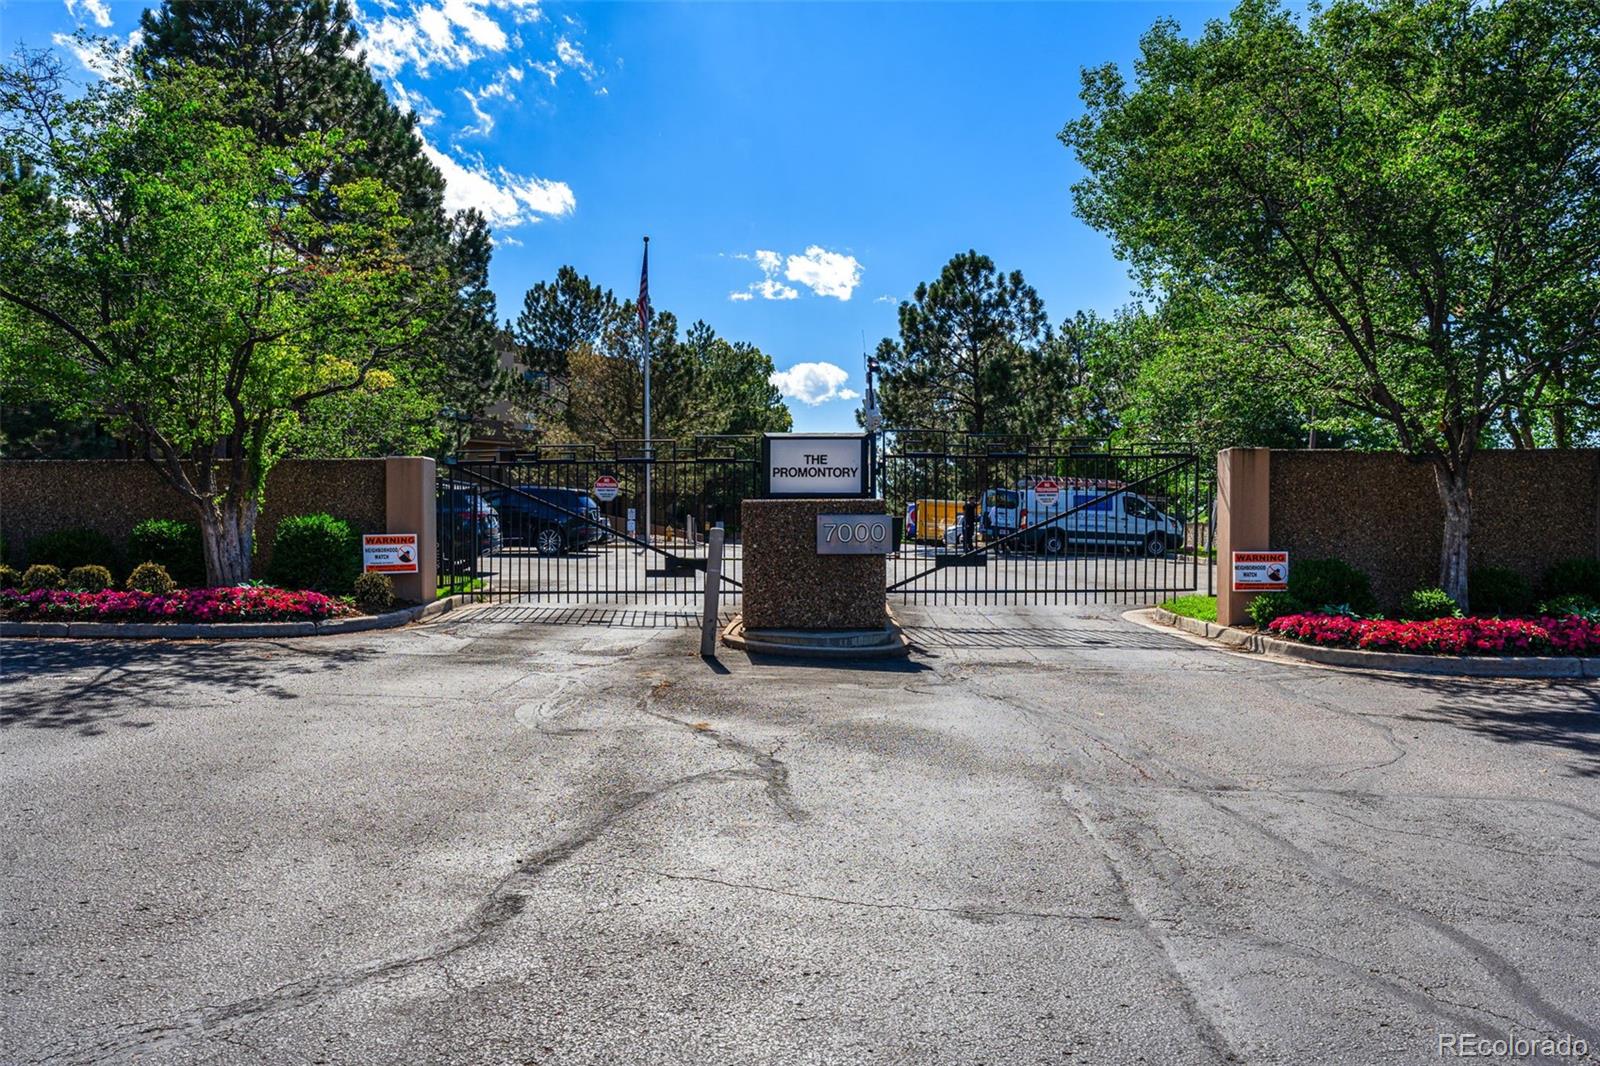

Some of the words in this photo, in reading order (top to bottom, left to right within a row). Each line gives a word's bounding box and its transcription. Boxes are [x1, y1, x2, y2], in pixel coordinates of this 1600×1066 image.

[804, 454, 828, 465] THE
[772, 467, 858, 478] PROMONTORY
[823, 523, 886, 542] 7000
[366, 536, 415, 545] WARNING
[1236, 554, 1285, 562] WARNING
